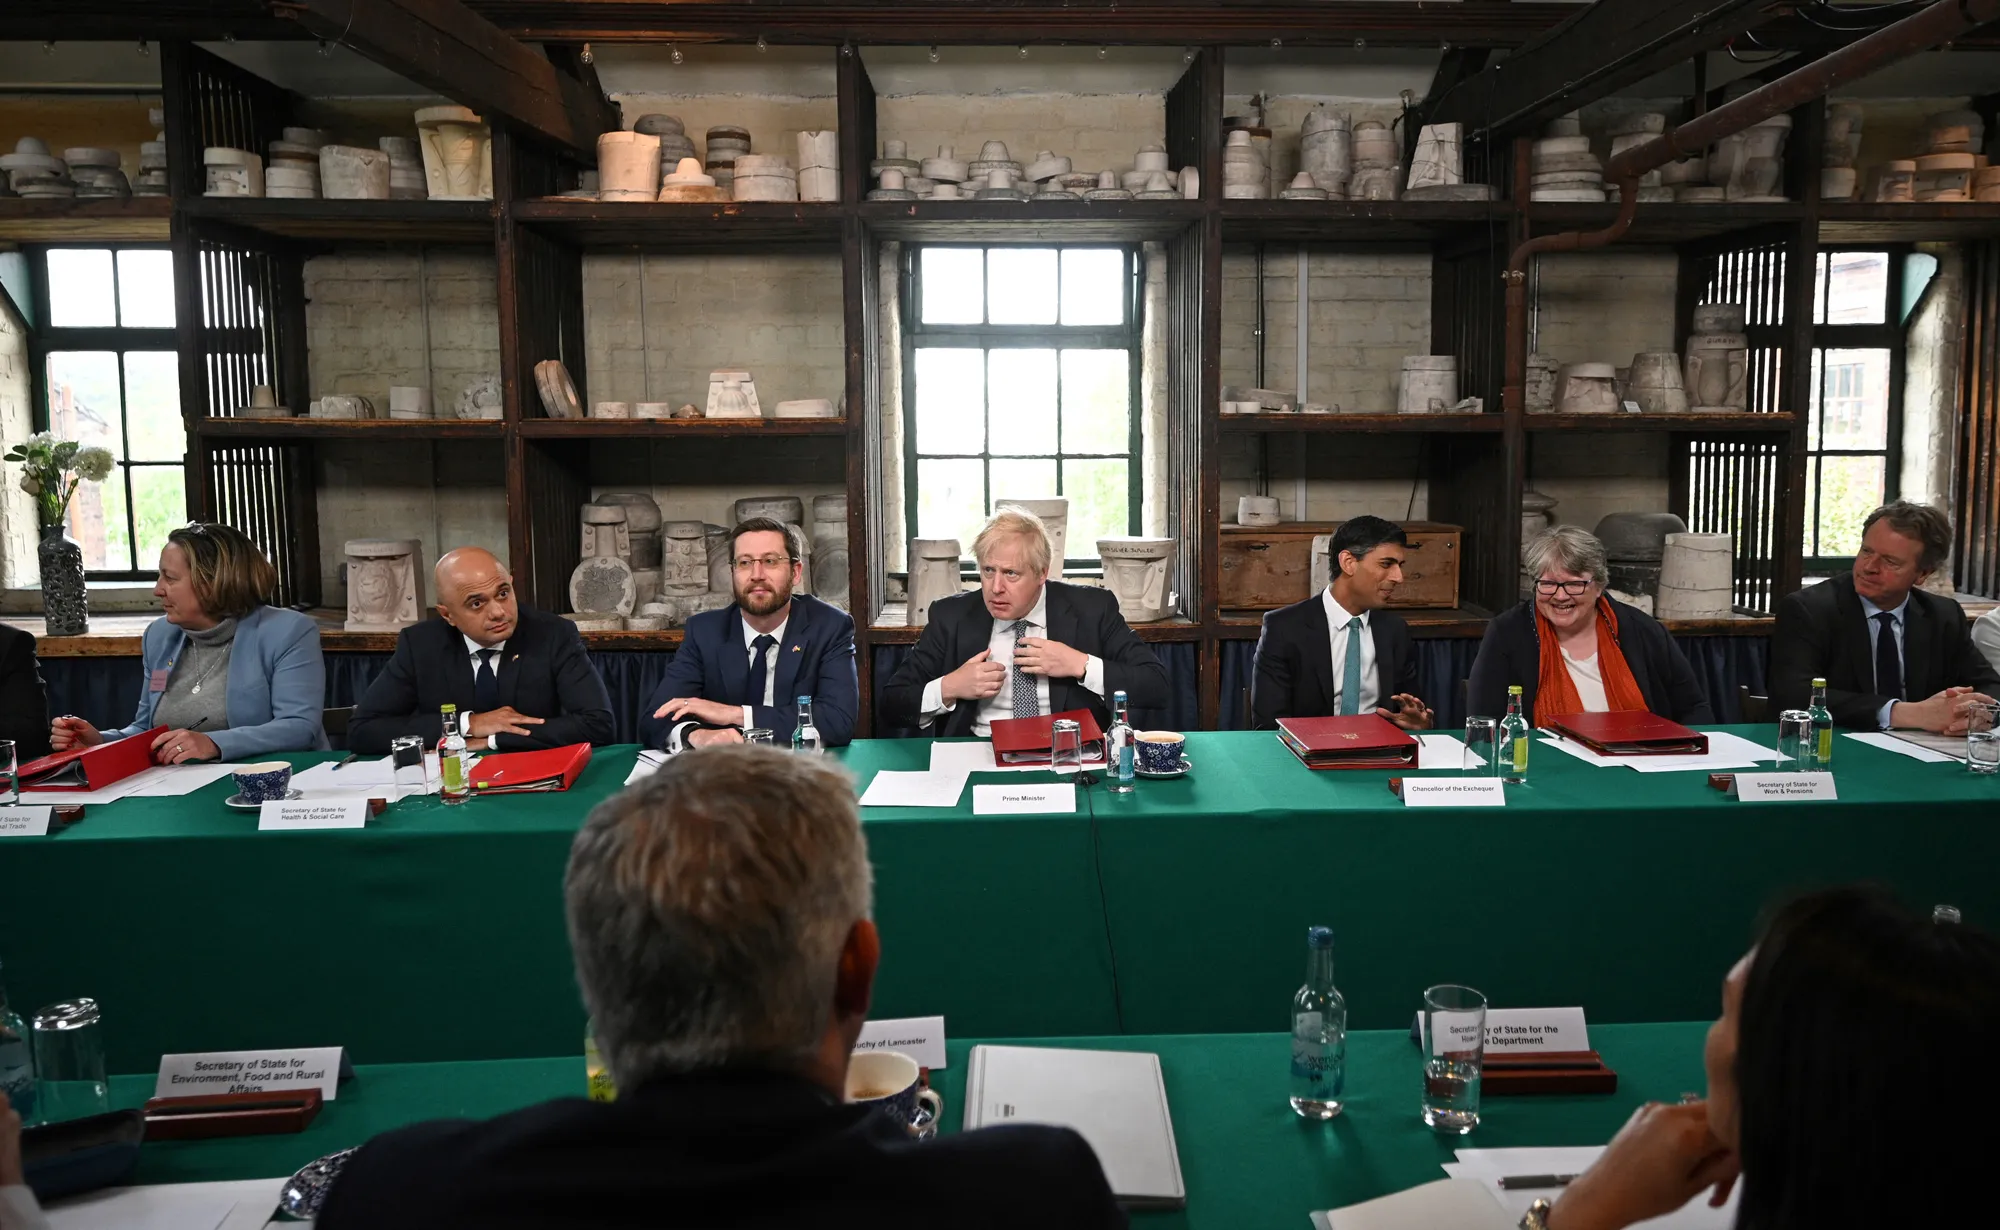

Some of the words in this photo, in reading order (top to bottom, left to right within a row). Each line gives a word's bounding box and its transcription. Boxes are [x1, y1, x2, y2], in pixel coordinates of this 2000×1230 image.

[1493, 1026, 1502, 1034] of
[1504, 1026, 1527, 1034] State
[1529, 1026, 1542, 1034] for
[1544, 1025, 1558, 1034] the
[888, 1038, 926, 1047] Lancaster
[1492, 1036, 1544, 1047] Department
[194, 1060, 244, 1072] Secretary
[248, 1060, 258, 1069] of
[261, 1059, 287, 1069] State
[289, 1058, 305, 1067] for
[171, 1073, 241, 1084] Environment,
[244, 1071, 271, 1081] Food
[273, 1069, 292, 1080] and
[295, 1069, 325, 1080] Rural
[228, 1085, 263, 1094] Affairs
